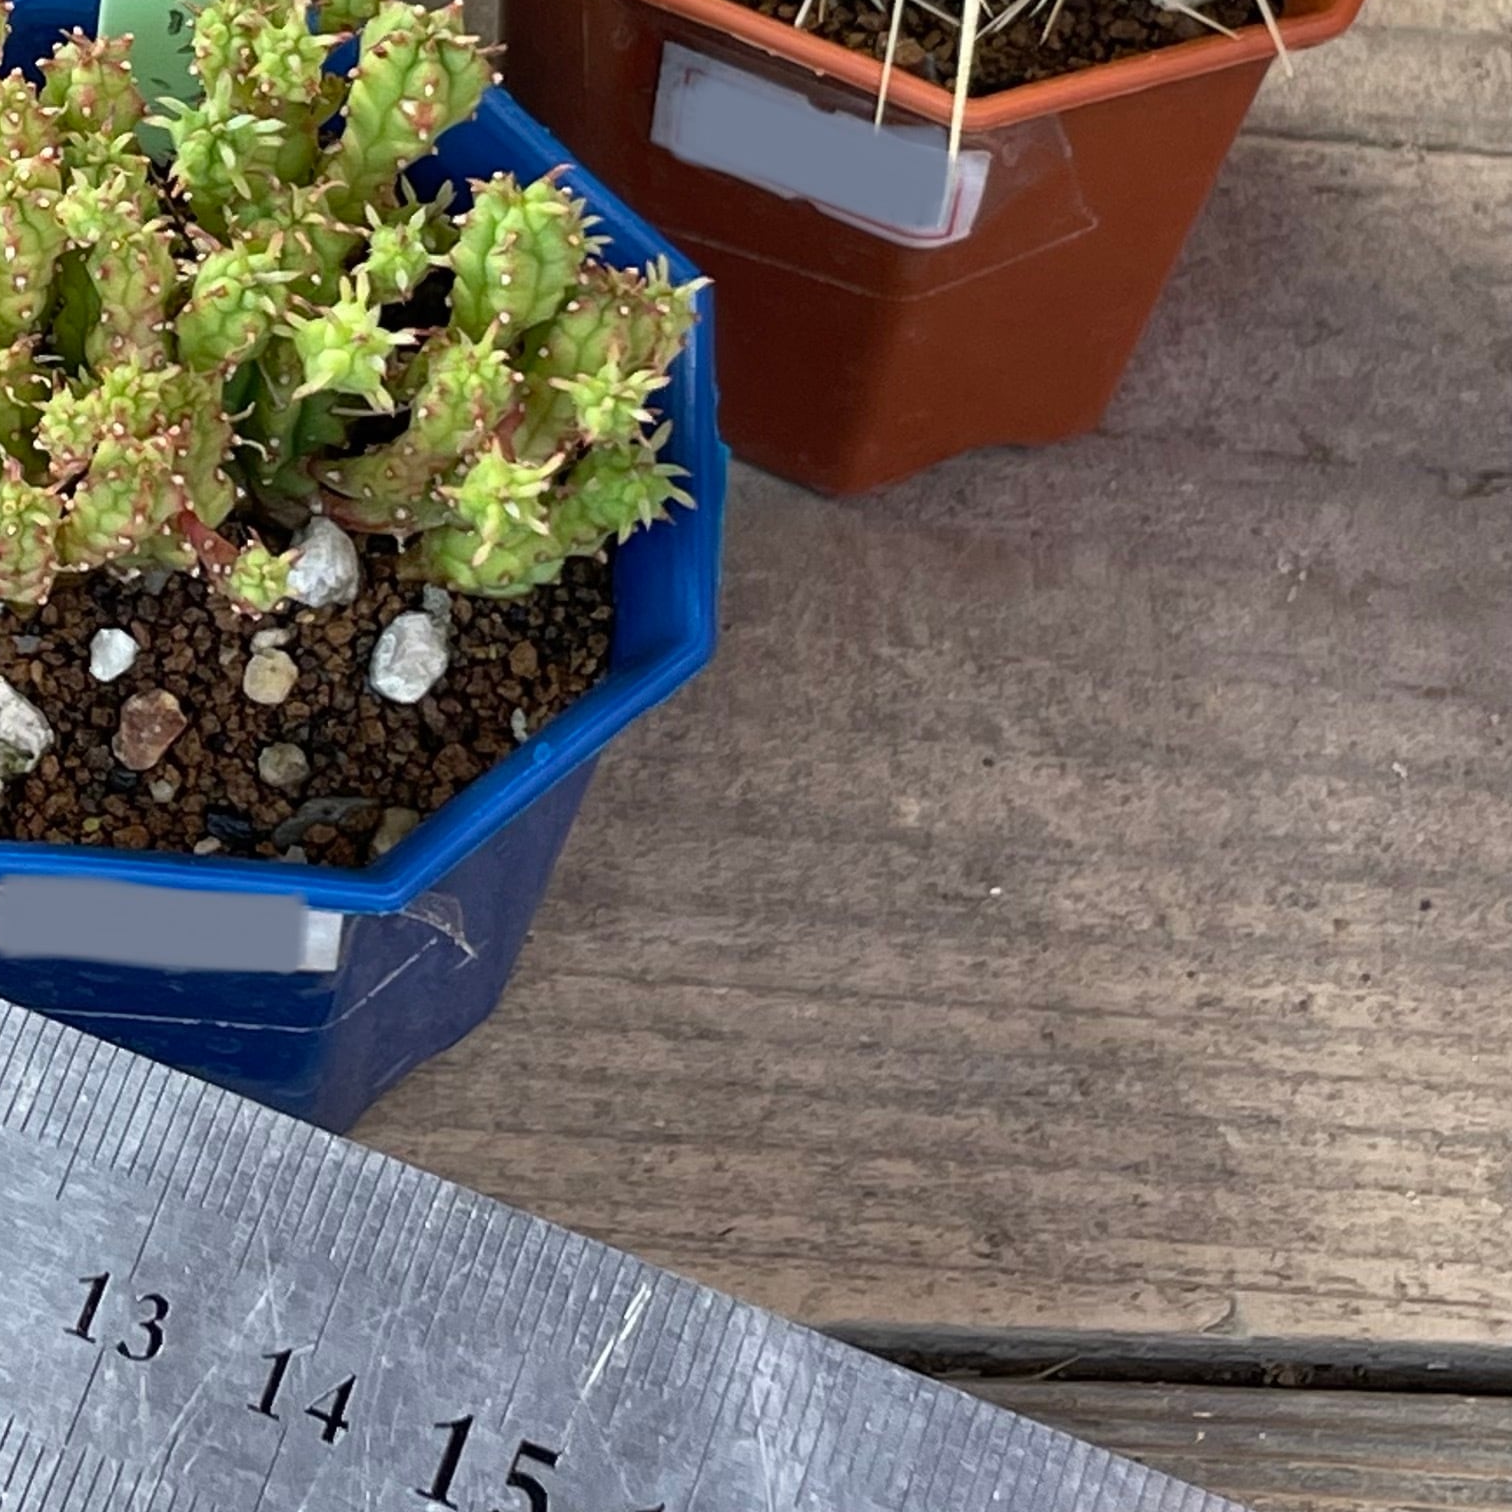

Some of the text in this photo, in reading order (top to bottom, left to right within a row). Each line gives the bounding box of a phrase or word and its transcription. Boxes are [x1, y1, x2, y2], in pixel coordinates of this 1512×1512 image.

[64, 1271, 170, 1361] 13
[246, 1347, 357, 1444] 14
[415, 1414, 563, 1512] 15
